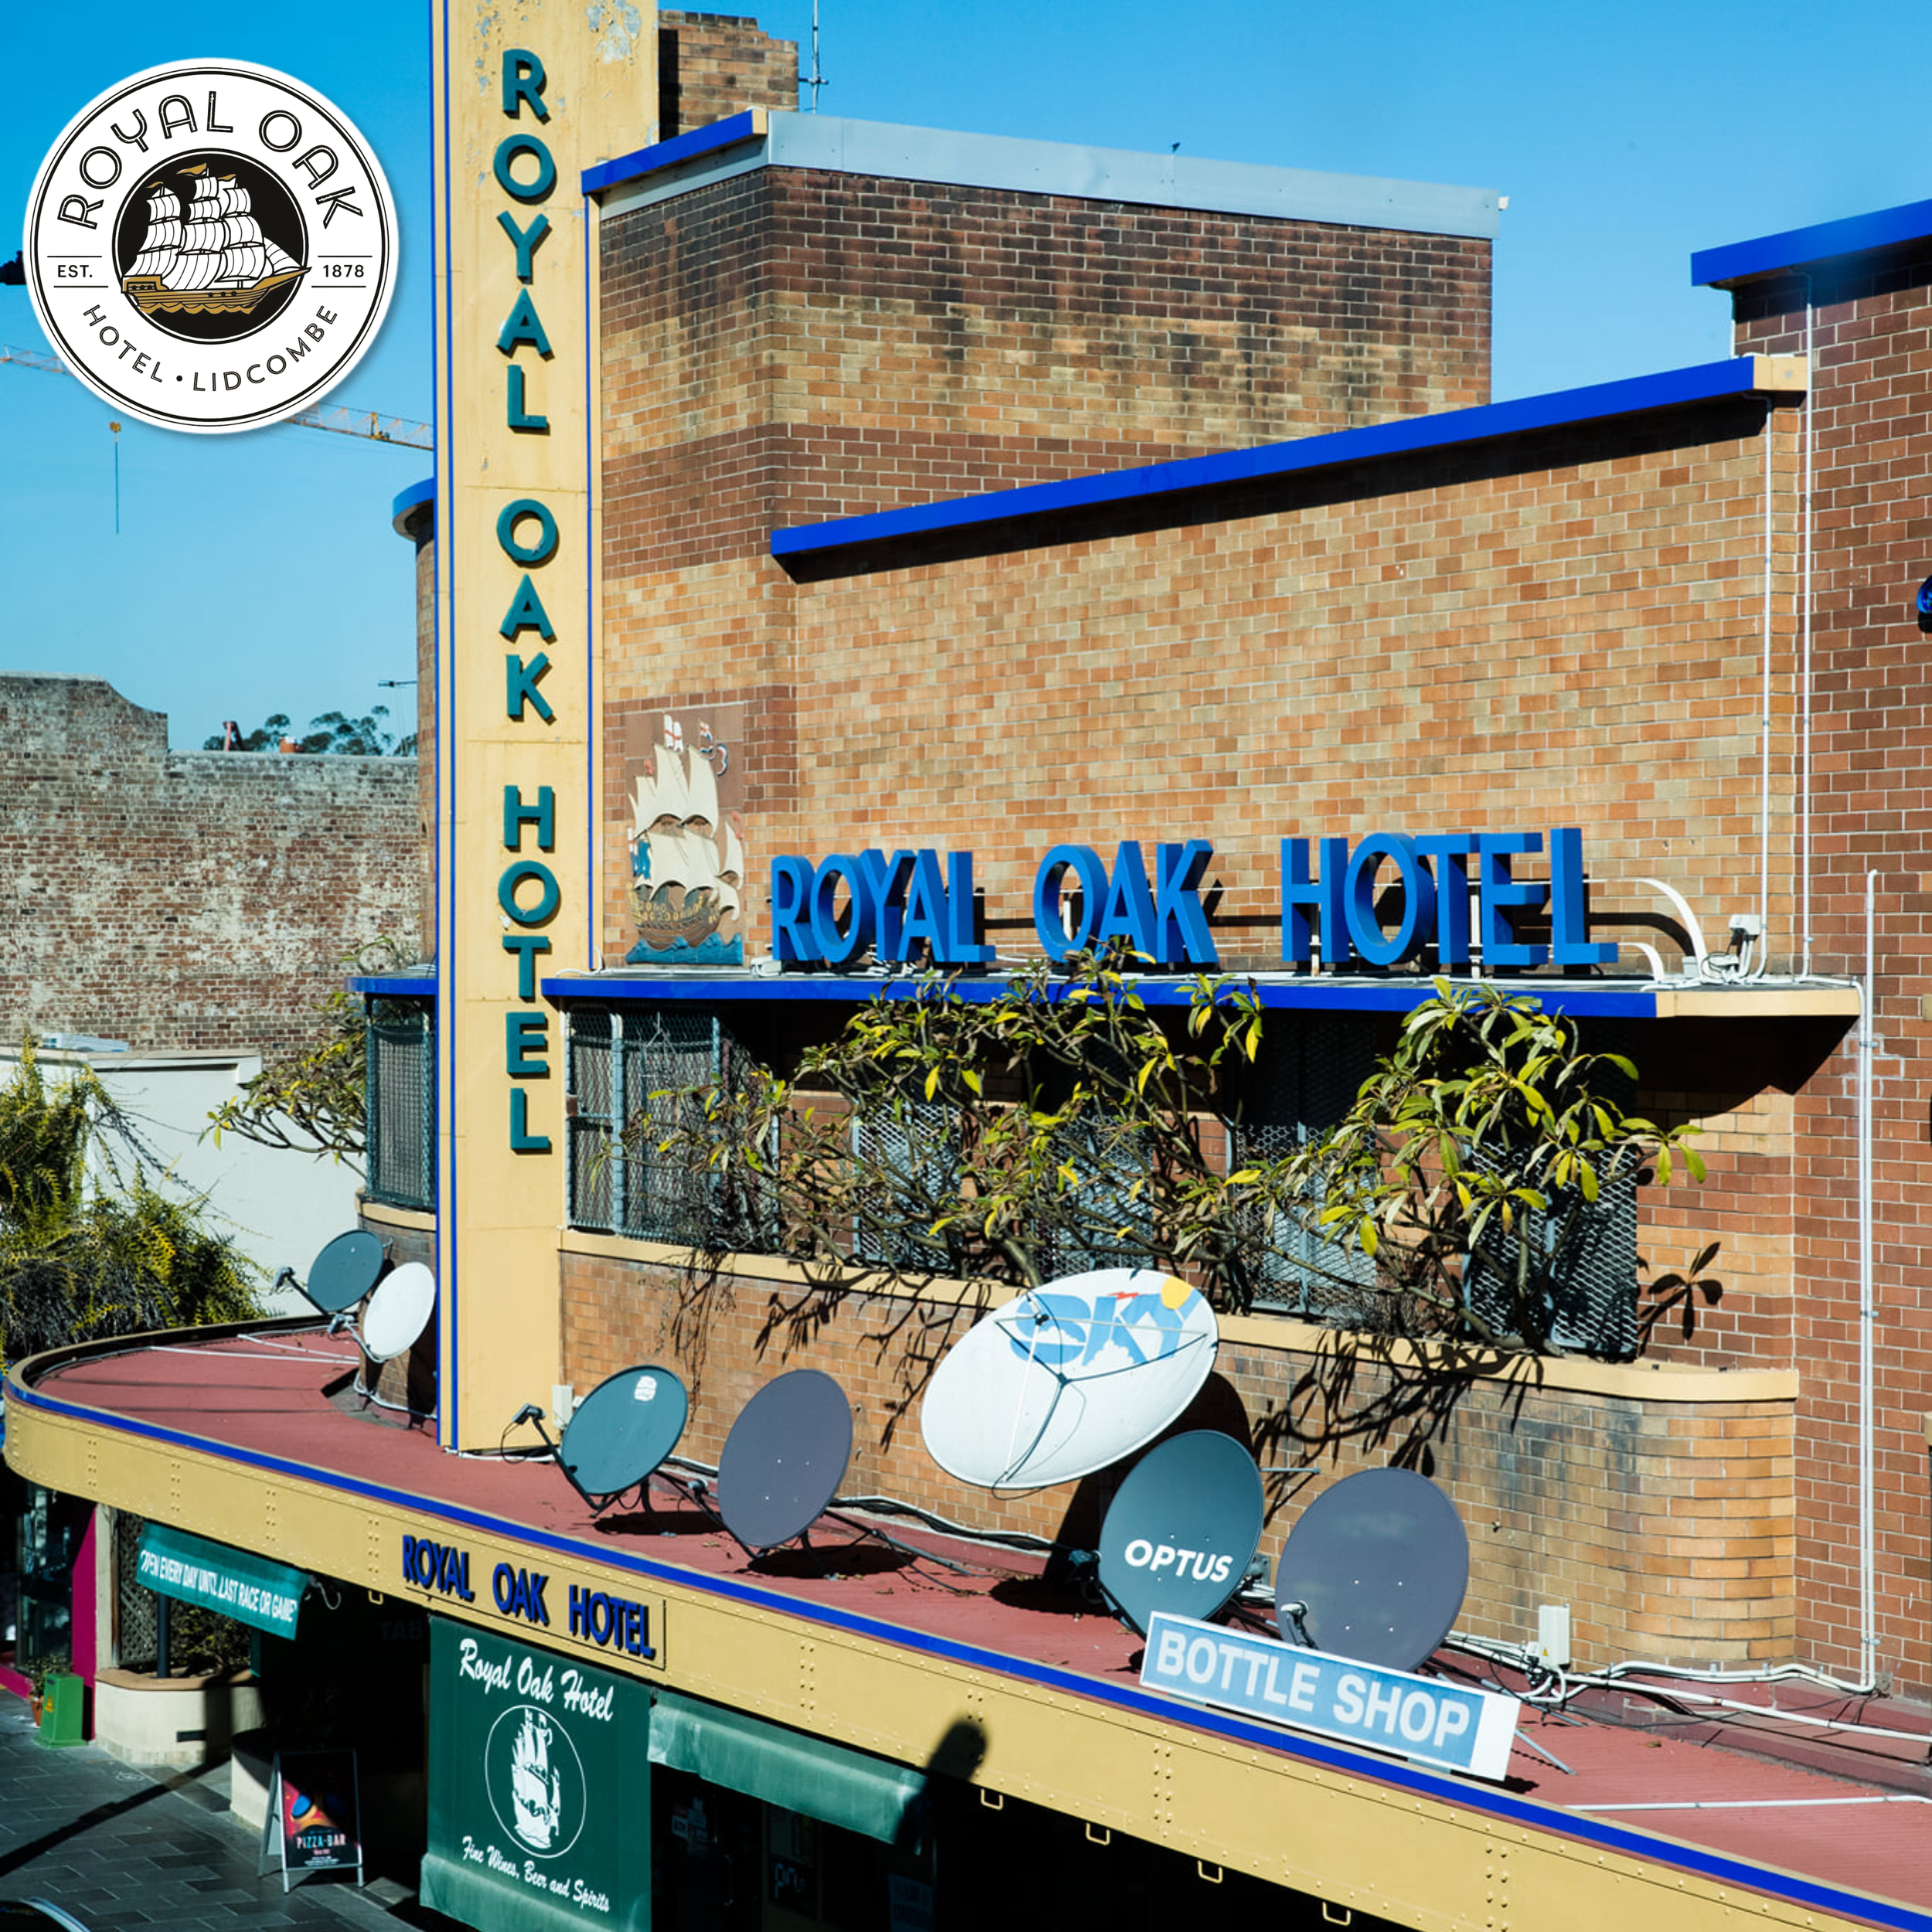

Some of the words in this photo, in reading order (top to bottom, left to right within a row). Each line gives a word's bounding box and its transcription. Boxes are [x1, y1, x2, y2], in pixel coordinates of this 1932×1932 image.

[493, 48, 556, 433] ROYAL
[495, 498, 558, 721] OAK
[771, 849, 995, 963] ROYAL
[1034, 839, 1218, 964] OAK
[1281, 828, 1618, 966] HOTEL
[498, 784, 559, 1154] HOTEL
[1010, 1287, 1203, 1367] SKY
[159, 1556, 184, 1584] EVERY
[182, 1563, 199, 1589] DAY
[218, 1575, 239, 1604] LAST
[238, 1583, 260, 1612] RACE
[259, 1590, 272, 1617] OR
[402, 1534, 475, 1603] ROYAL
[492, 1563, 550, 1628] OAK
[569, 1584, 656, 1661] HOTEL
[1124, 1539, 1234, 1583] OPTUS
[459, 1638, 512, 1695] Royal
[518, 1656, 554, 1703] Oak
[561, 1669, 614, 1722] Hotel
[1156, 1629, 1321, 1712] BOTTLE
[1332, 1674, 1470, 1747] SHOP
[462, 1835, 485, 1861] Fine
[487, 1845, 520, 1880] Wines,
[523, 1859, 548, 1889] Beer
[549, 1878, 571, 1898] and
[573, 1879, 611, 1913] Spirits
